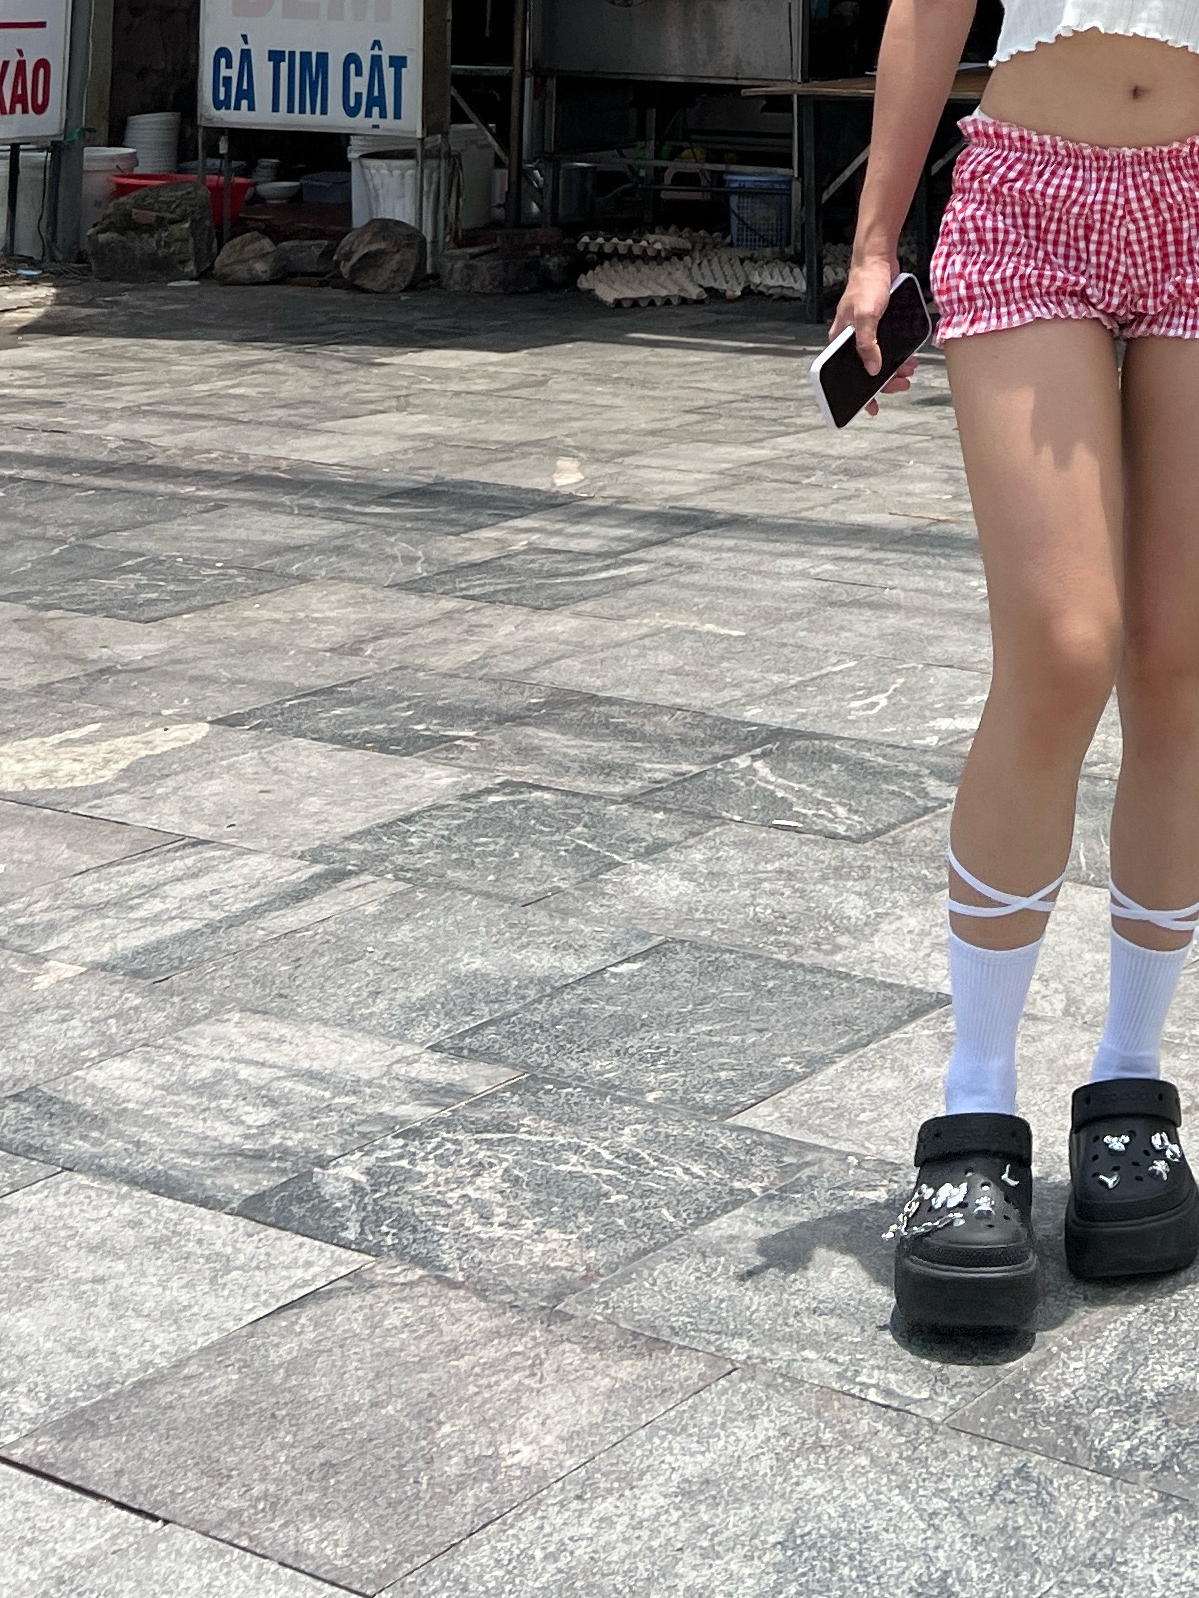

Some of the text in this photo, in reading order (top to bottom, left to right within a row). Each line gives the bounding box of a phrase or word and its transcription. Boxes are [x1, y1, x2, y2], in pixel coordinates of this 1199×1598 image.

[212, 33, 409, 129] GÀ TIM CẬT
